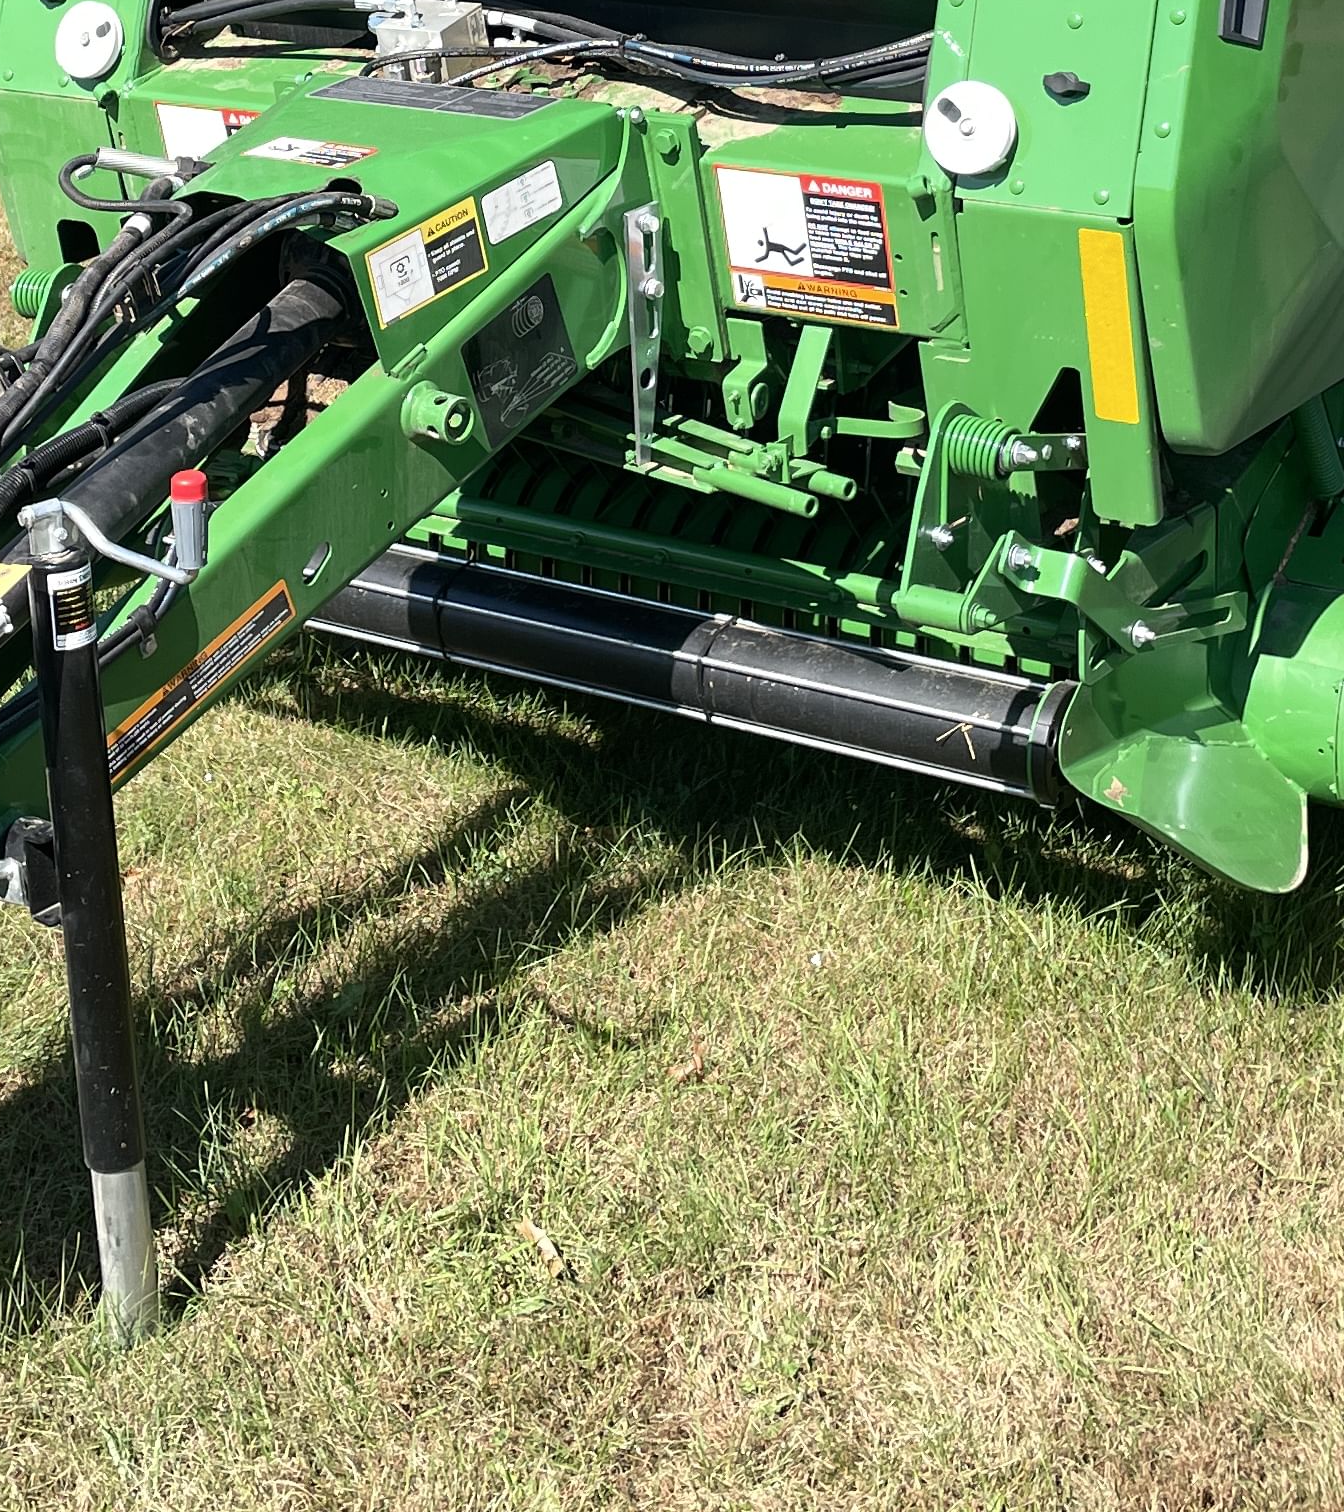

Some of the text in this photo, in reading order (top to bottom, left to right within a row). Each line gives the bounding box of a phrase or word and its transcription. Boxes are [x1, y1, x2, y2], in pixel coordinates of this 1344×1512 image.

[822, 182, 873, 199] DANGER
[435, 208, 469, 232] CAUTION
[806, 283, 858, 299] WARNING
[167, 652, 208, 691] WARNING
